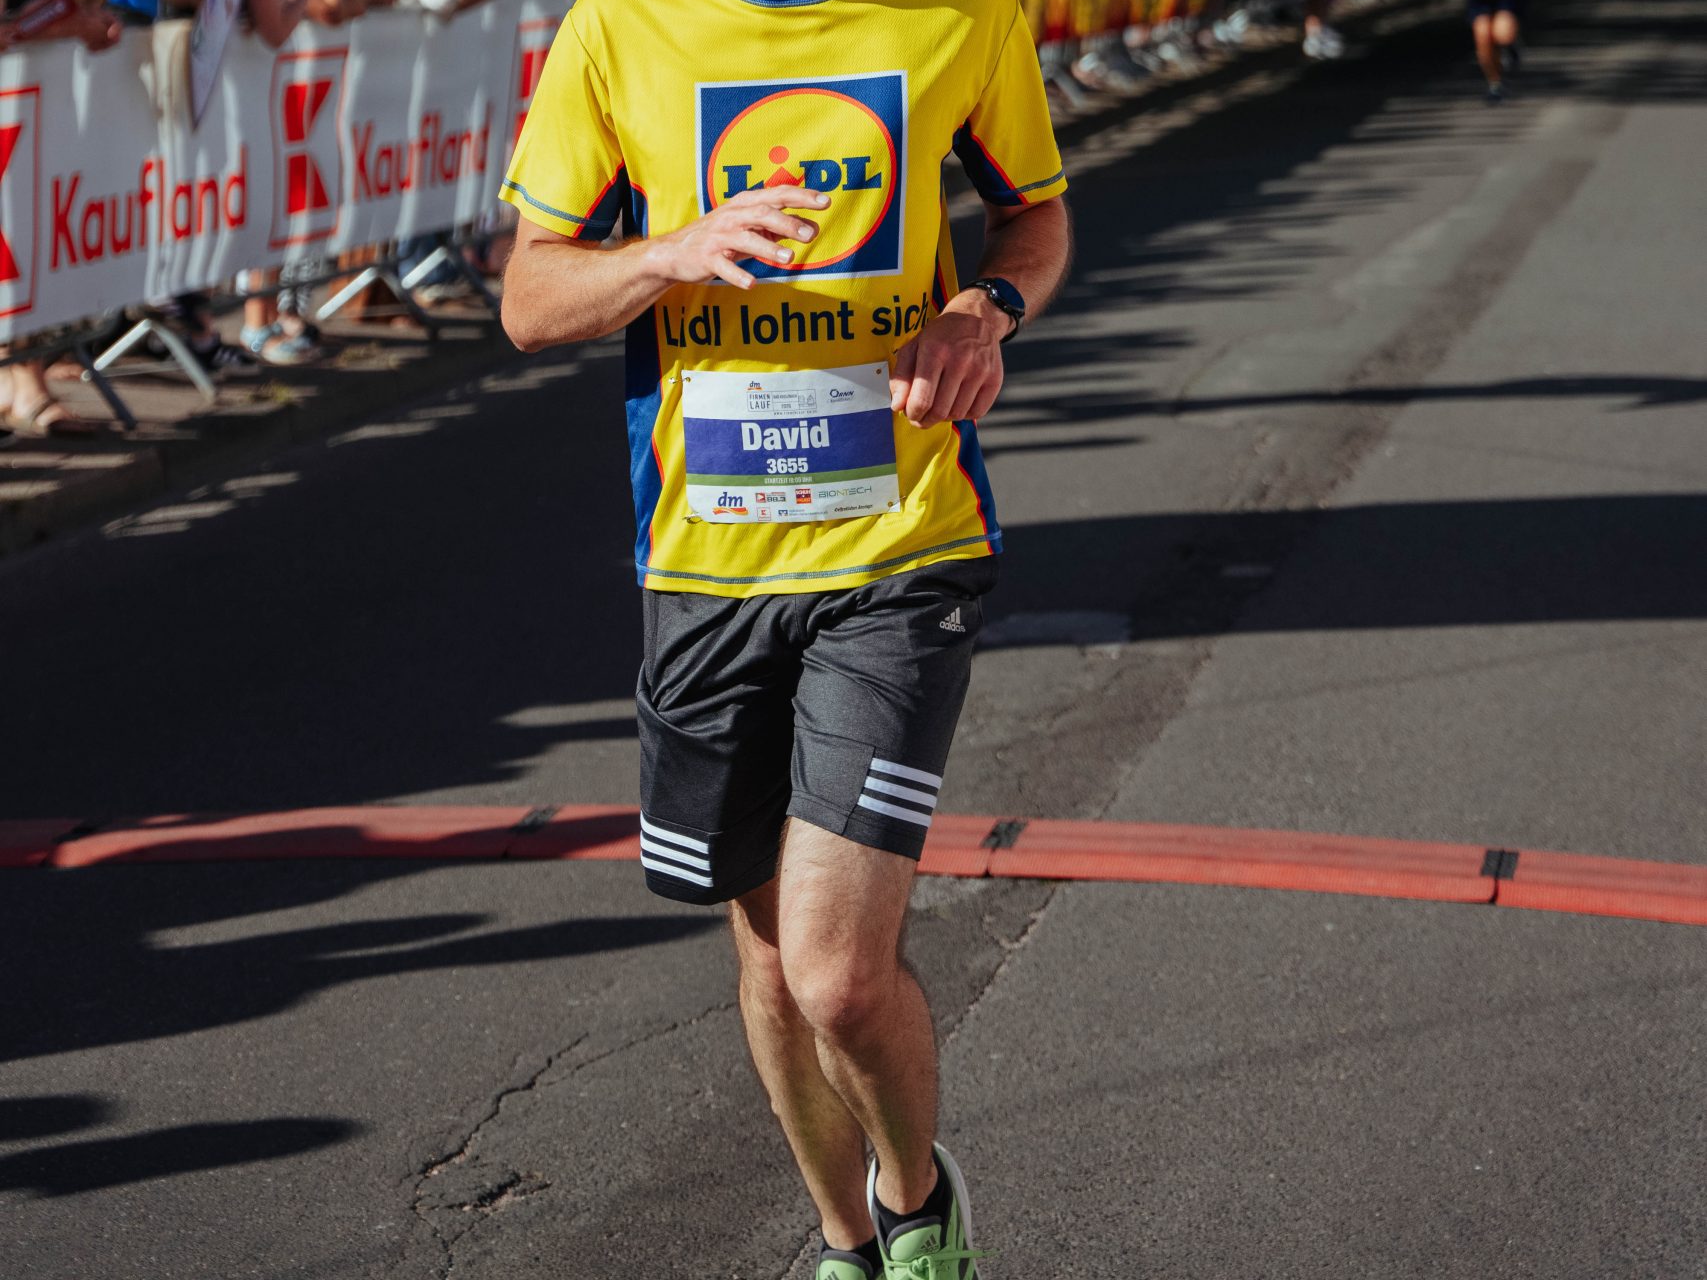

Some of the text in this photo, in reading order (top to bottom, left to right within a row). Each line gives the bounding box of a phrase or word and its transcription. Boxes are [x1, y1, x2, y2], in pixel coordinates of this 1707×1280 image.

[353, 104, 493, 202] Kaufland
[51, 145, 247, 270] Kaufland
[663, 305, 721, 347] Lidl
[741, 301, 854, 345] lohnt
[749, 401, 771, 410] LAUF
[741, 418, 830, 451] David
[766, 457, 809, 474] 3655
[717, 491, 744, 508] dm
[818, 485, 873, 499] BIONTECH
[939, 620, 966, 632] adidas
